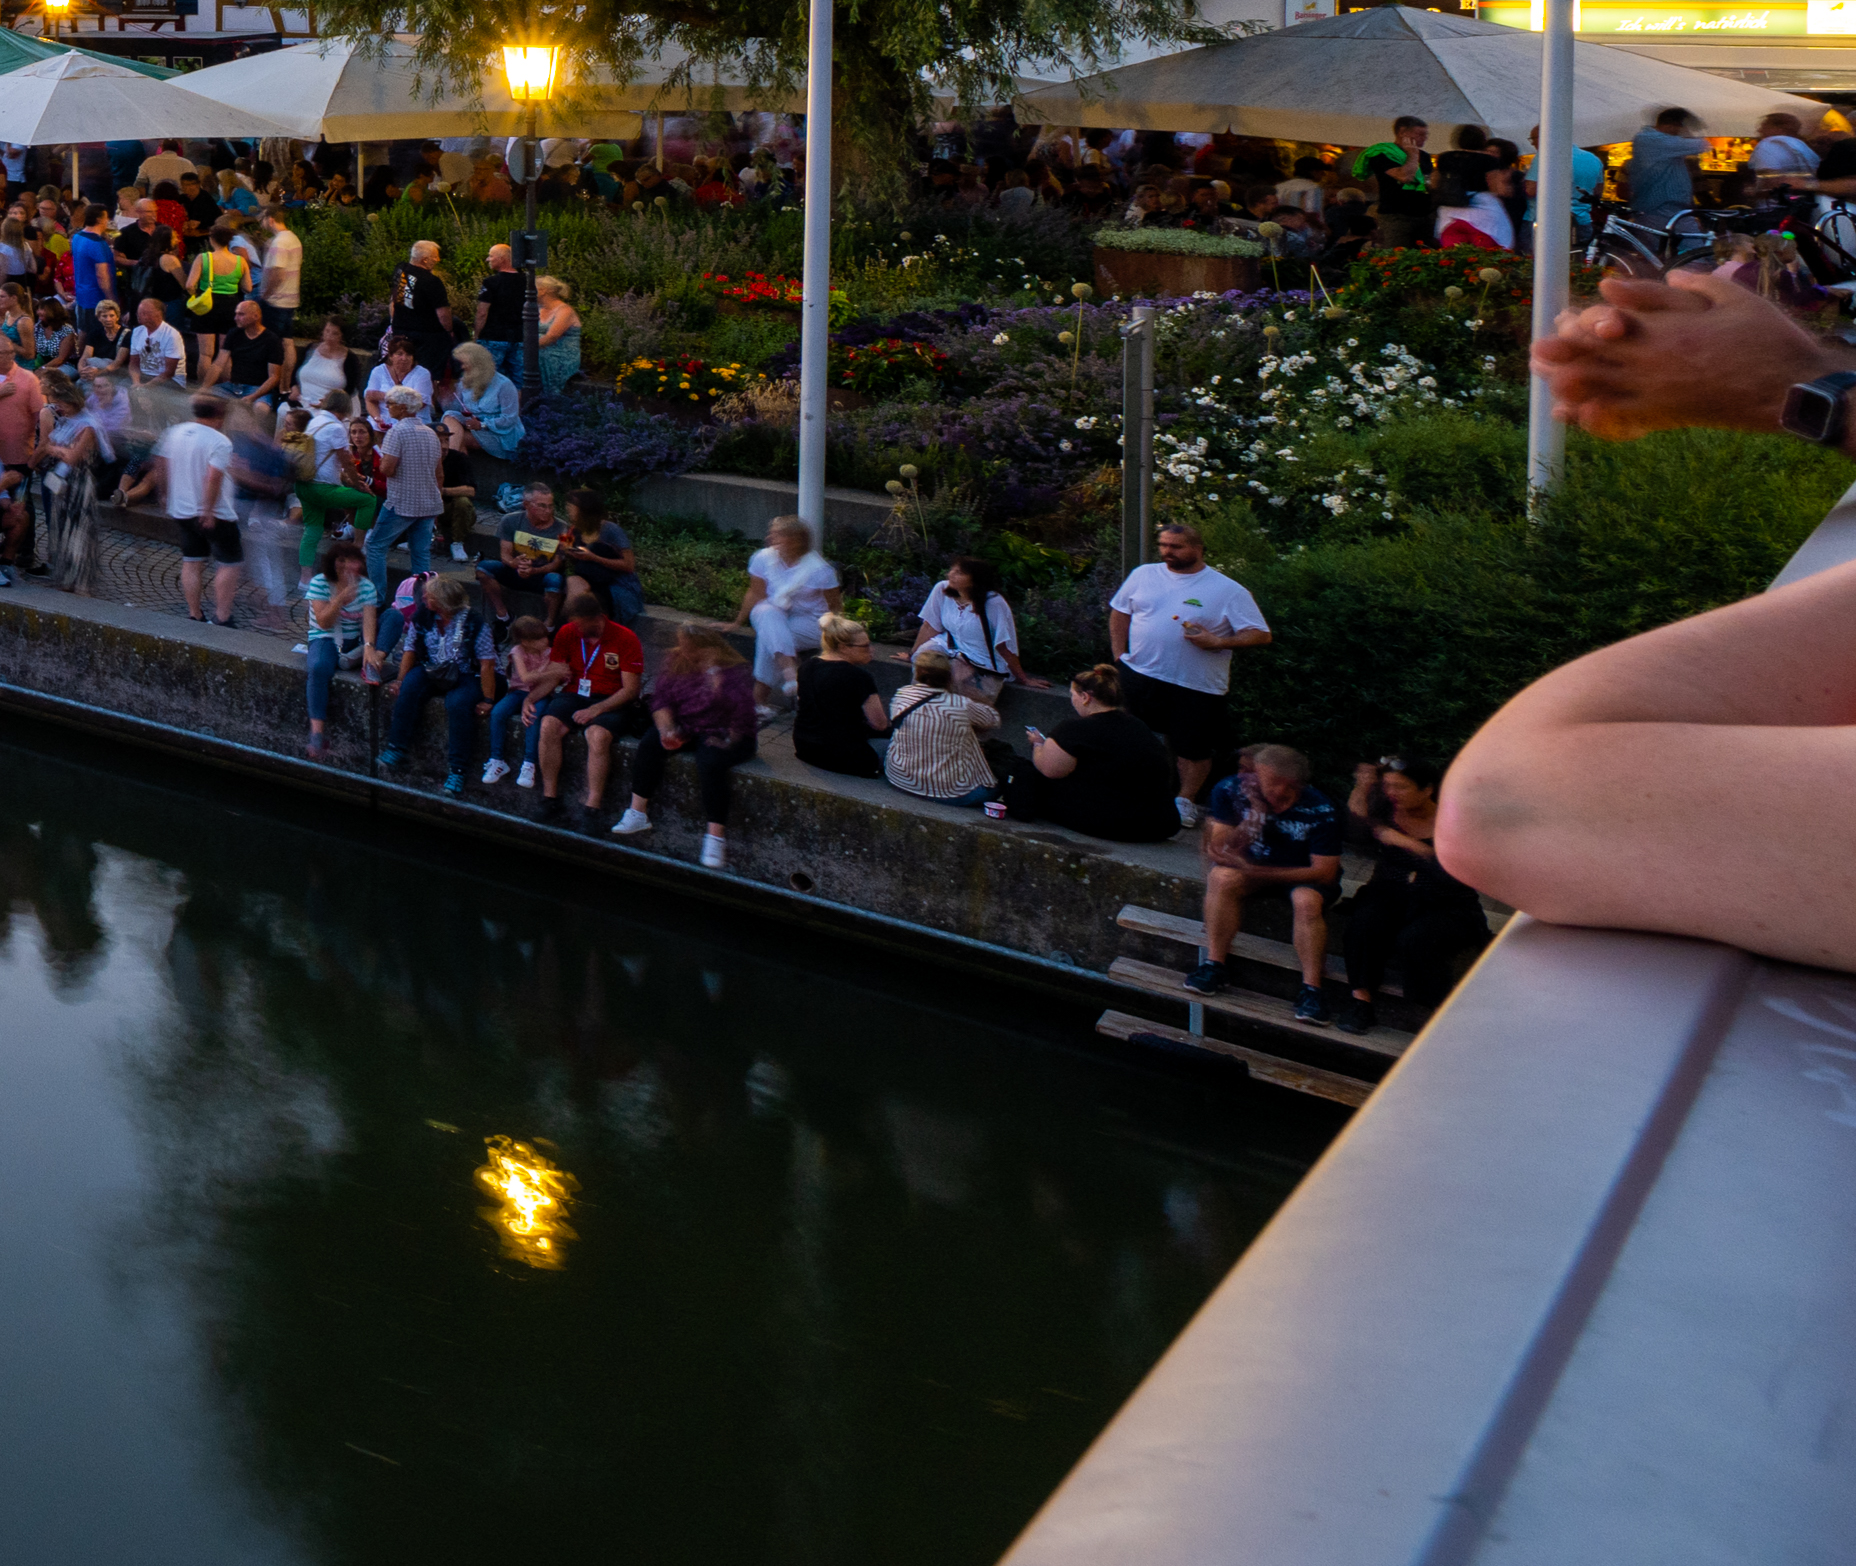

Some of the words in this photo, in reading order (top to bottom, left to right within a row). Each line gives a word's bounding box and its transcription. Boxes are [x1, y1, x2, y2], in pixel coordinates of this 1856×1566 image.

[1615, 16, 1644, 31] Ich
[1645, 16, 1687, 31] will's
[1693, 10, 1770, 30] natürlich
